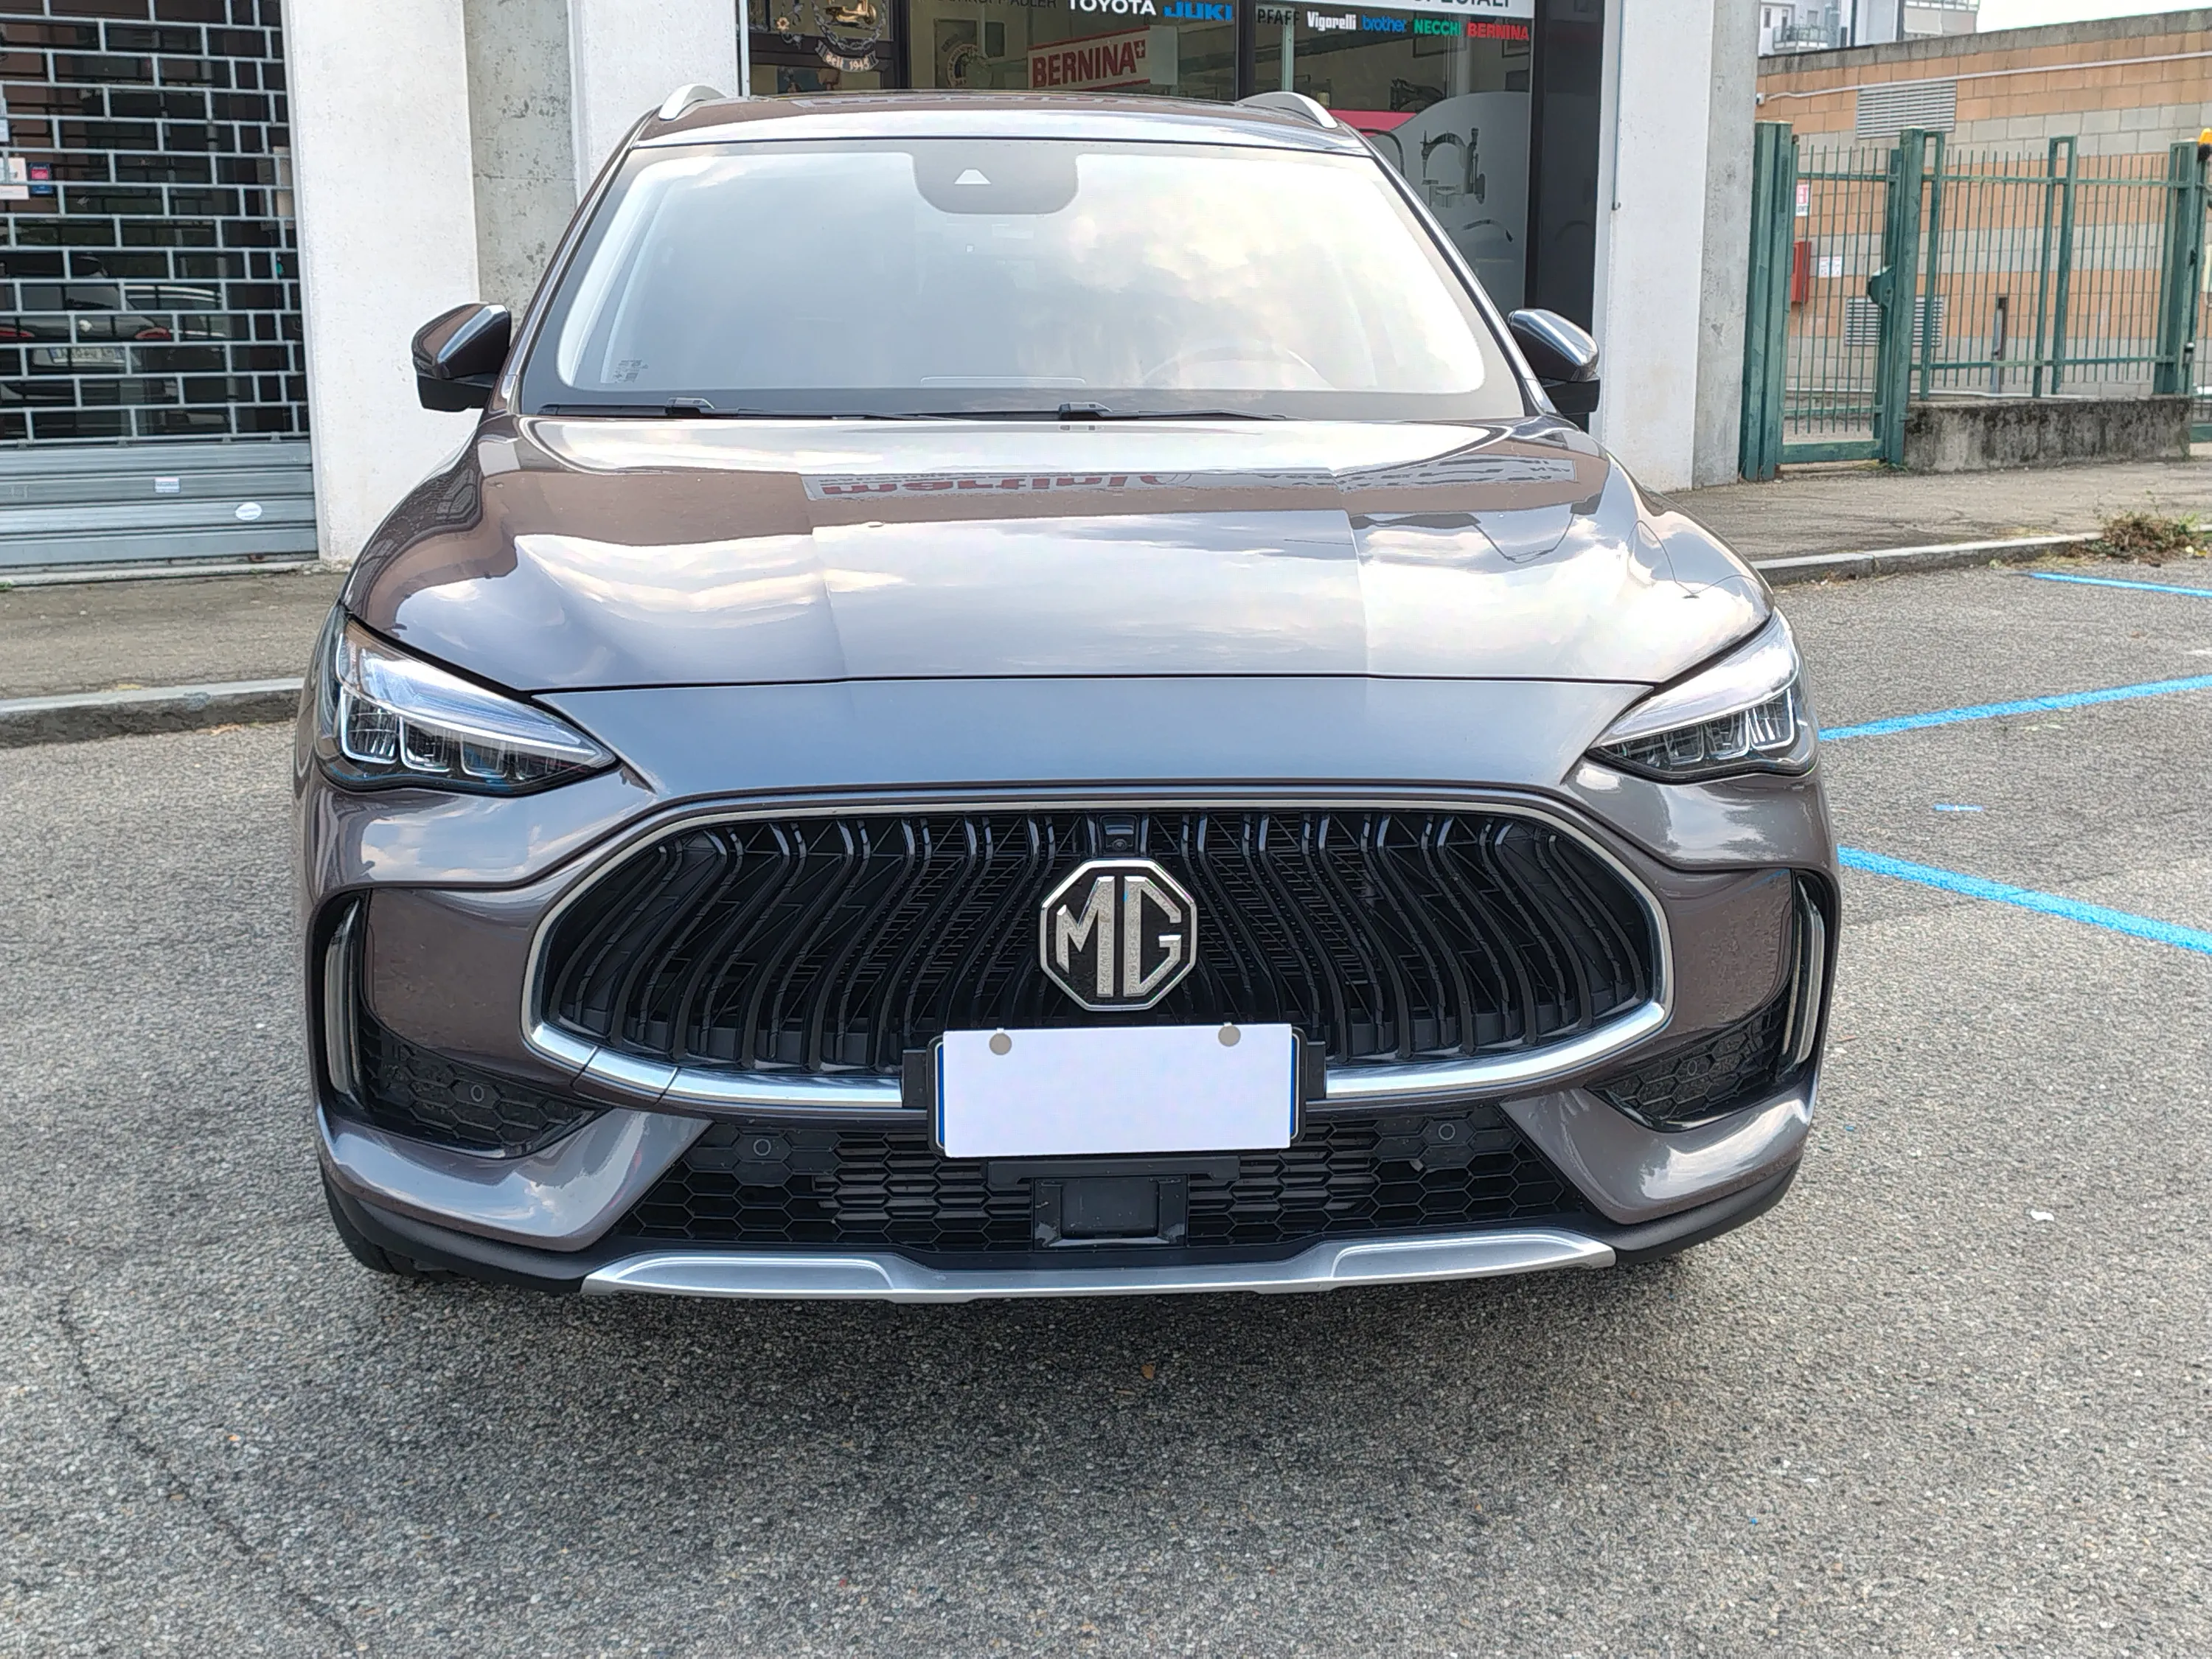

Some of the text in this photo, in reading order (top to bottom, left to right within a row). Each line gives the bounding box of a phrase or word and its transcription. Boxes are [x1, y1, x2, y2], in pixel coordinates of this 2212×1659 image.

[1069, 0, 1157, 15] TOYOTA
[1163, 1, 1232, 21] JUKI
[1257, 8, 1300, 25] PFAFF
[1307, 11, 1356, 31] Vigorelli
[1362, 15, 1406, 32] brother
[1413, 18, 1461, 35] NECCHI
[1467, 22, 1529, 41] BERNINA
[1032, 41, 1137, 88] BERNINA
[1056, 875, 1182, 998] MG
